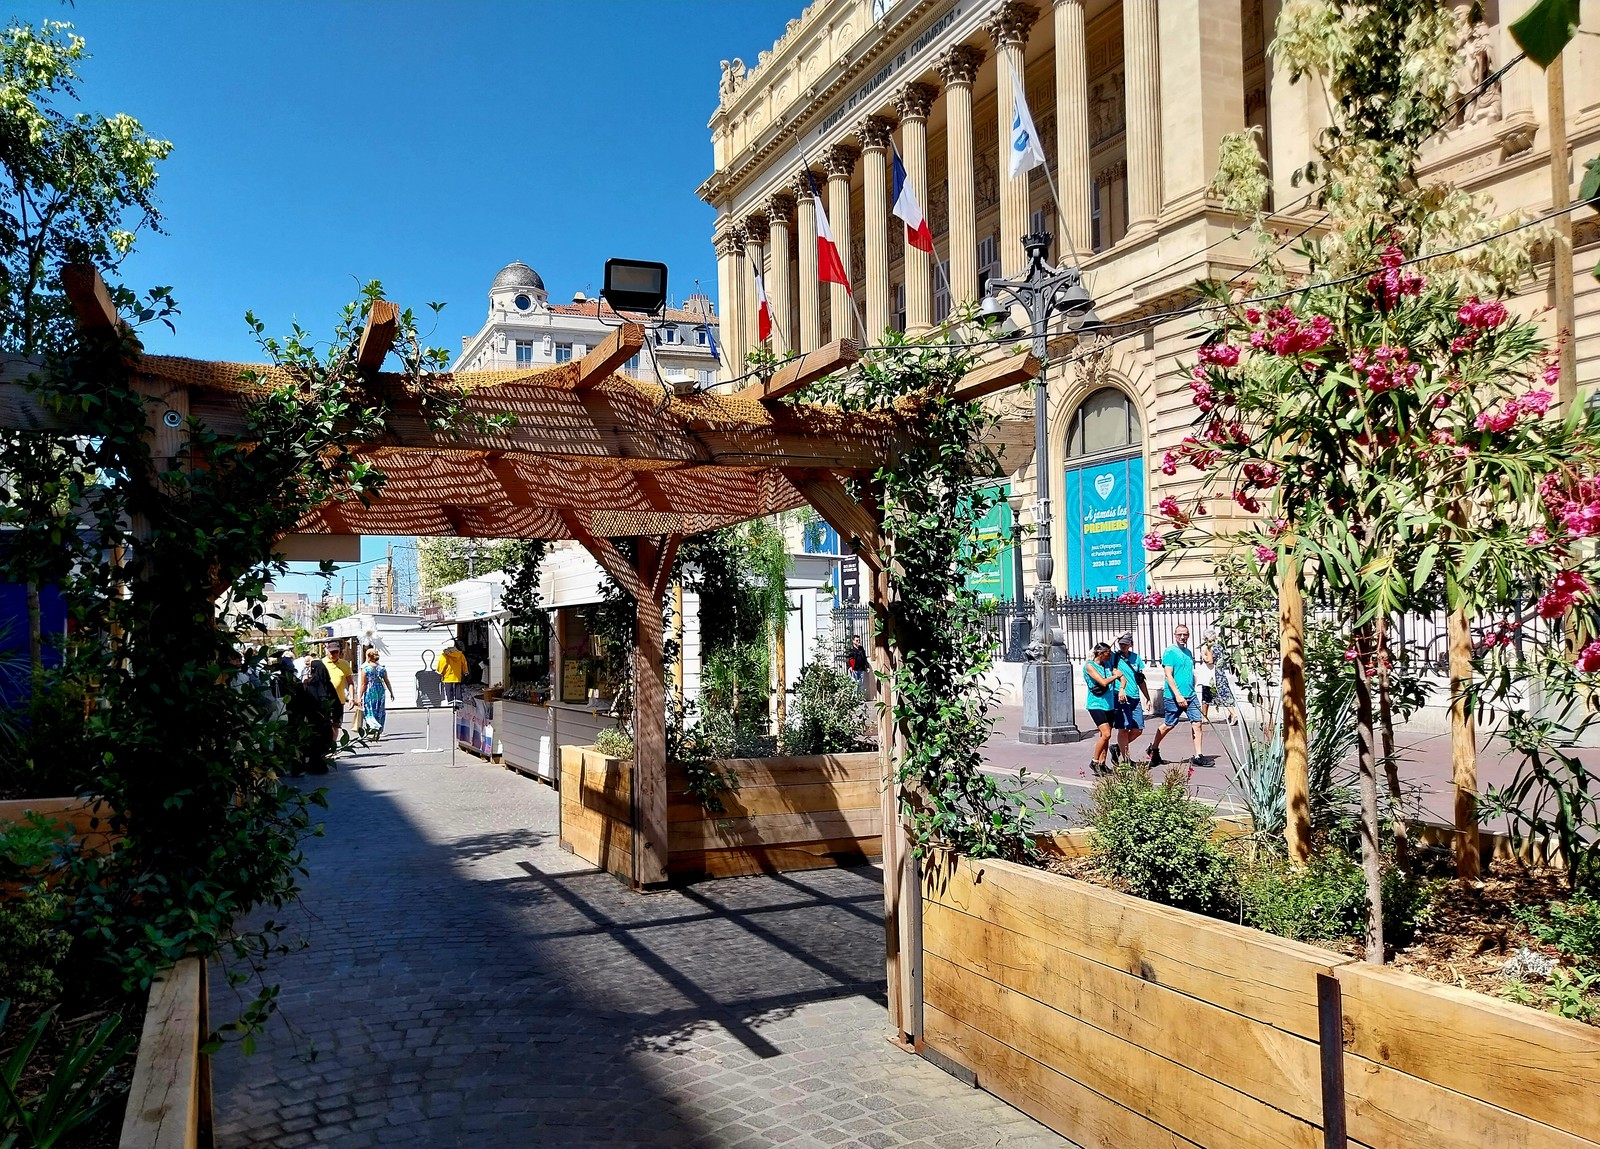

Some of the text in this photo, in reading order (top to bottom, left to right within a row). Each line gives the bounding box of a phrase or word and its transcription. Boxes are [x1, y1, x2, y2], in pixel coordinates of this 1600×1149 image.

[848, 94, 857, 110] ET
[859, 64, 892, 100] CHAMBRE
[897, 51, 907, 69] DE
[911, 9, 955, 56] COMMERCE
[1092, 506, 1117, 523] jamais
[1117, 505, 1128, 516] les
[1083, 519, 1129, 535] PREMIERS
